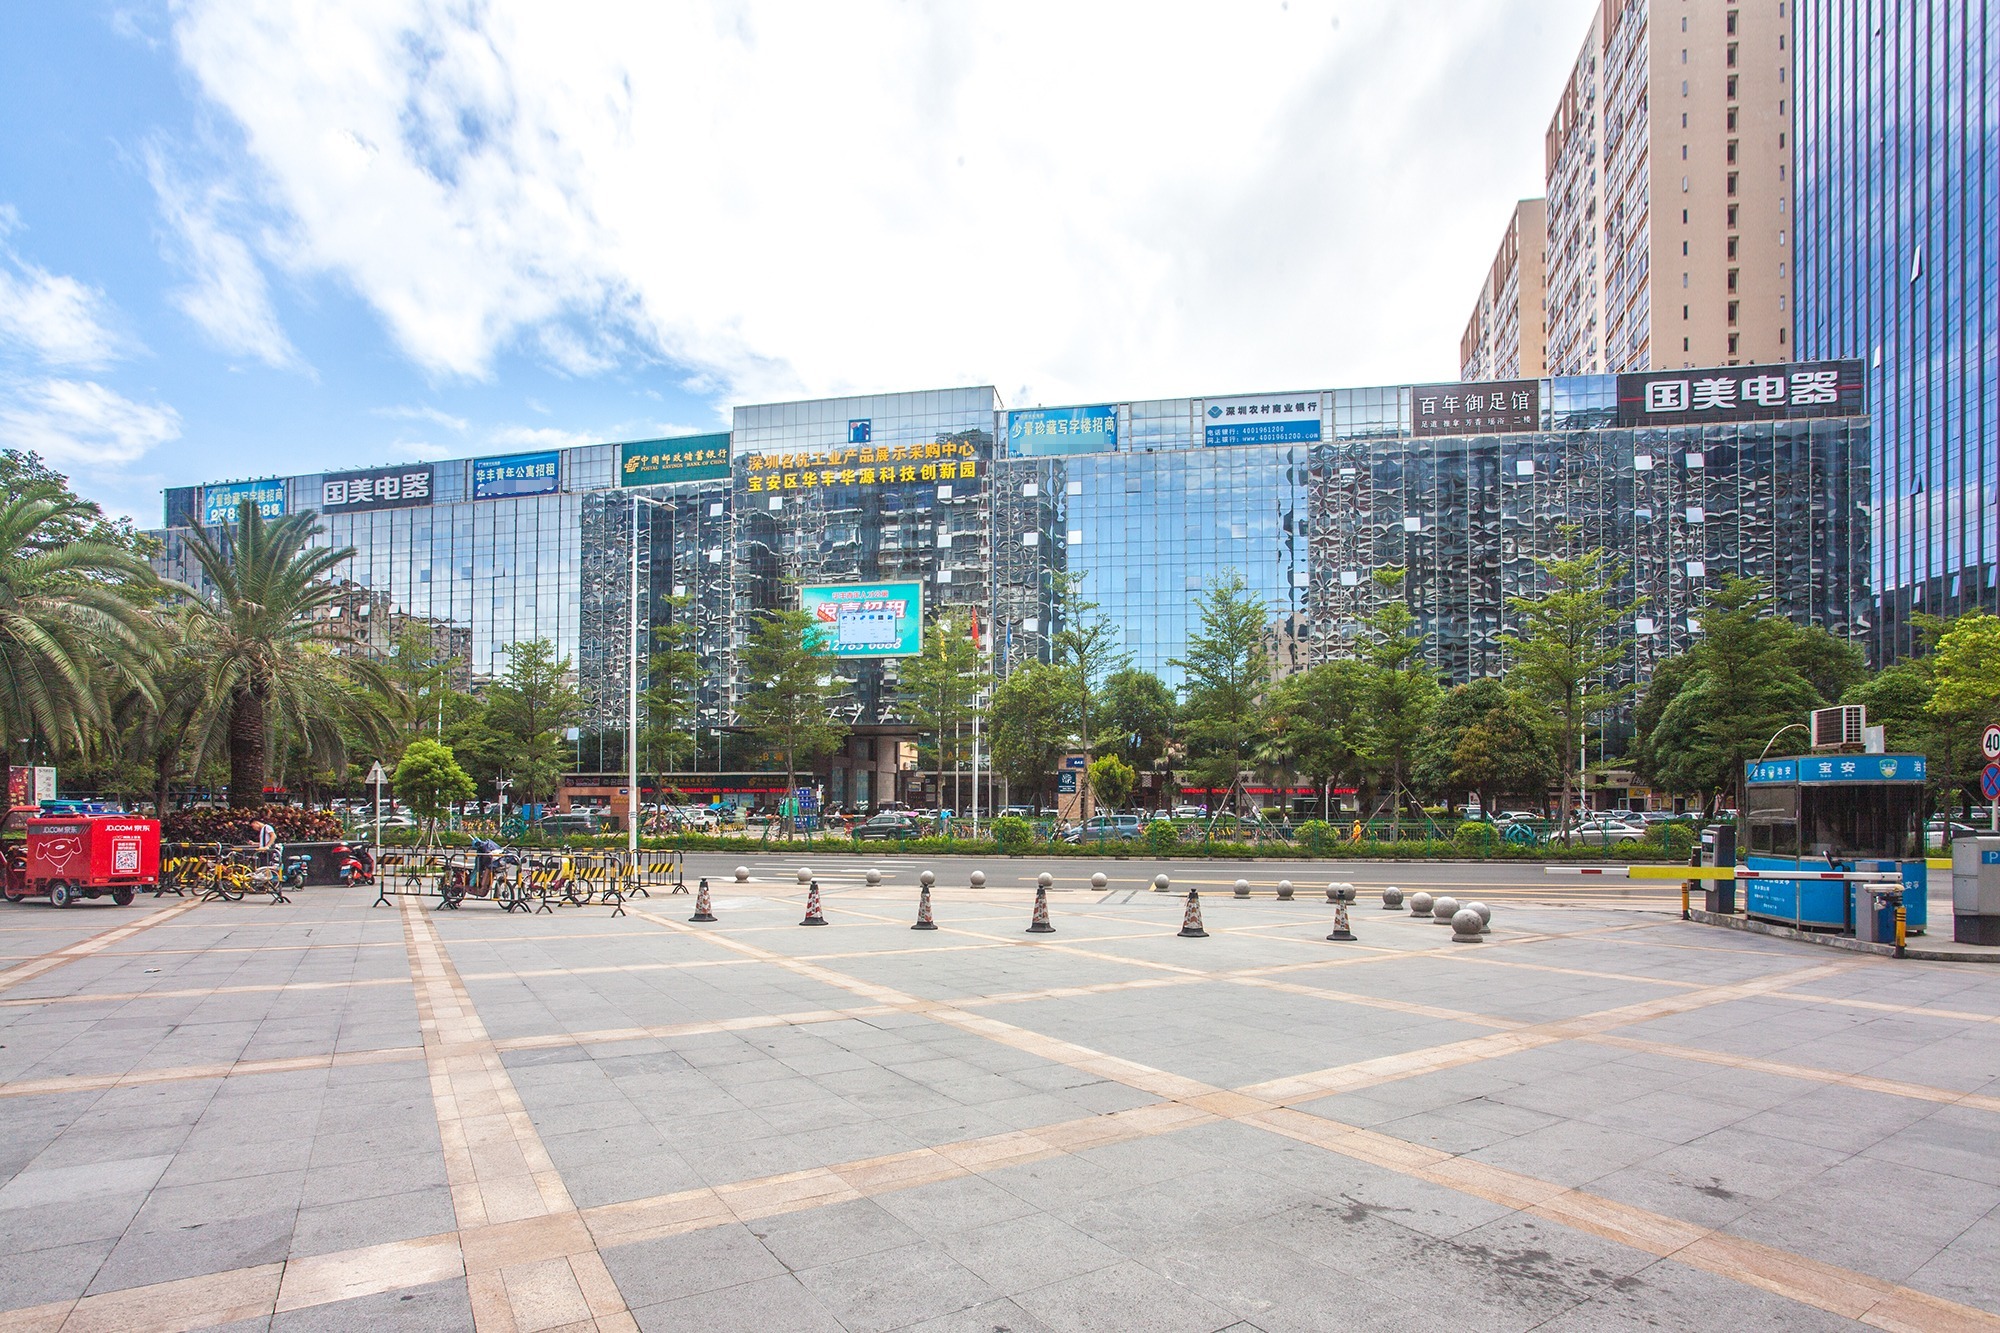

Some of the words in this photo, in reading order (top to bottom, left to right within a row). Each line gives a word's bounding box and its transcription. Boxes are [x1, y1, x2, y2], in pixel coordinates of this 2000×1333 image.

[1645, 371, 1838, 413] 国美电器
[1226, 402, 1317, 416] 深圳农村商业银行
[1419, 391, 1530, 415] 百年御足馆
[1012, 416, 1115, 439] 少量珍藏写字楼招商
[640, 448, 727, 467] 中国邮政储蓄银行
[748, 440, 976, 472] 深圳名优工业产品展示采购中心
[476, 463, 556, 483] 华丰青年公寓招租
[748, 461, 976, 493] 宝安区华丰华源科技创新园
[323, 472, 430, 507] 国美电器
[1985, 733, 2000, 751] 40
[1819, 762, 1856, 773] 宝安
[1989, 851, 1999, 864] P
